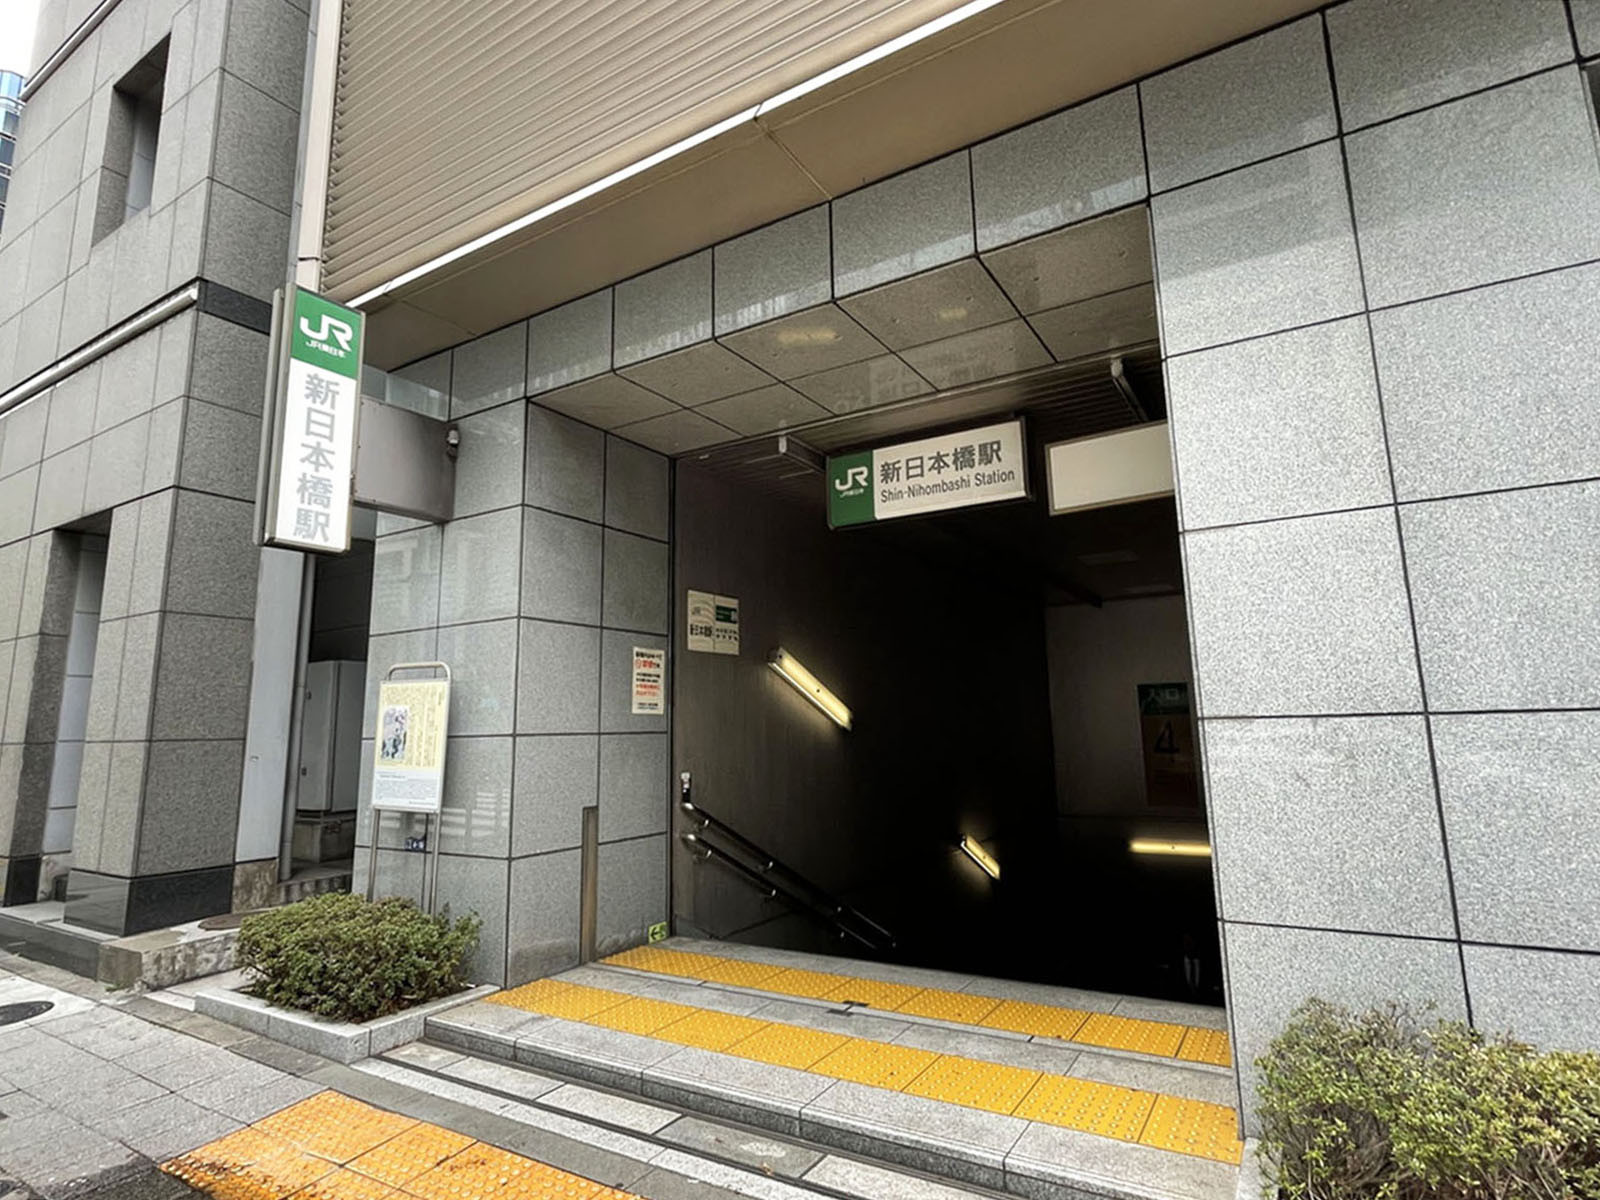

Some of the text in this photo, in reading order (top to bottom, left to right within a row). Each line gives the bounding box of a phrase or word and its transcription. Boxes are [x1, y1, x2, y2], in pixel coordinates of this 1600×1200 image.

[300, 314, 353, 353] JR
[293, 373, 340, 542] 新日本橋駅
[880, 440, 1002, 485] 新日本橋駅
[835, 466, 868, 490] JR
[881, 474, 970, 502] Shin-Nihombashi
[974, 469, 1016, 487] Station
[1154, 720, 1180, 752] 4
